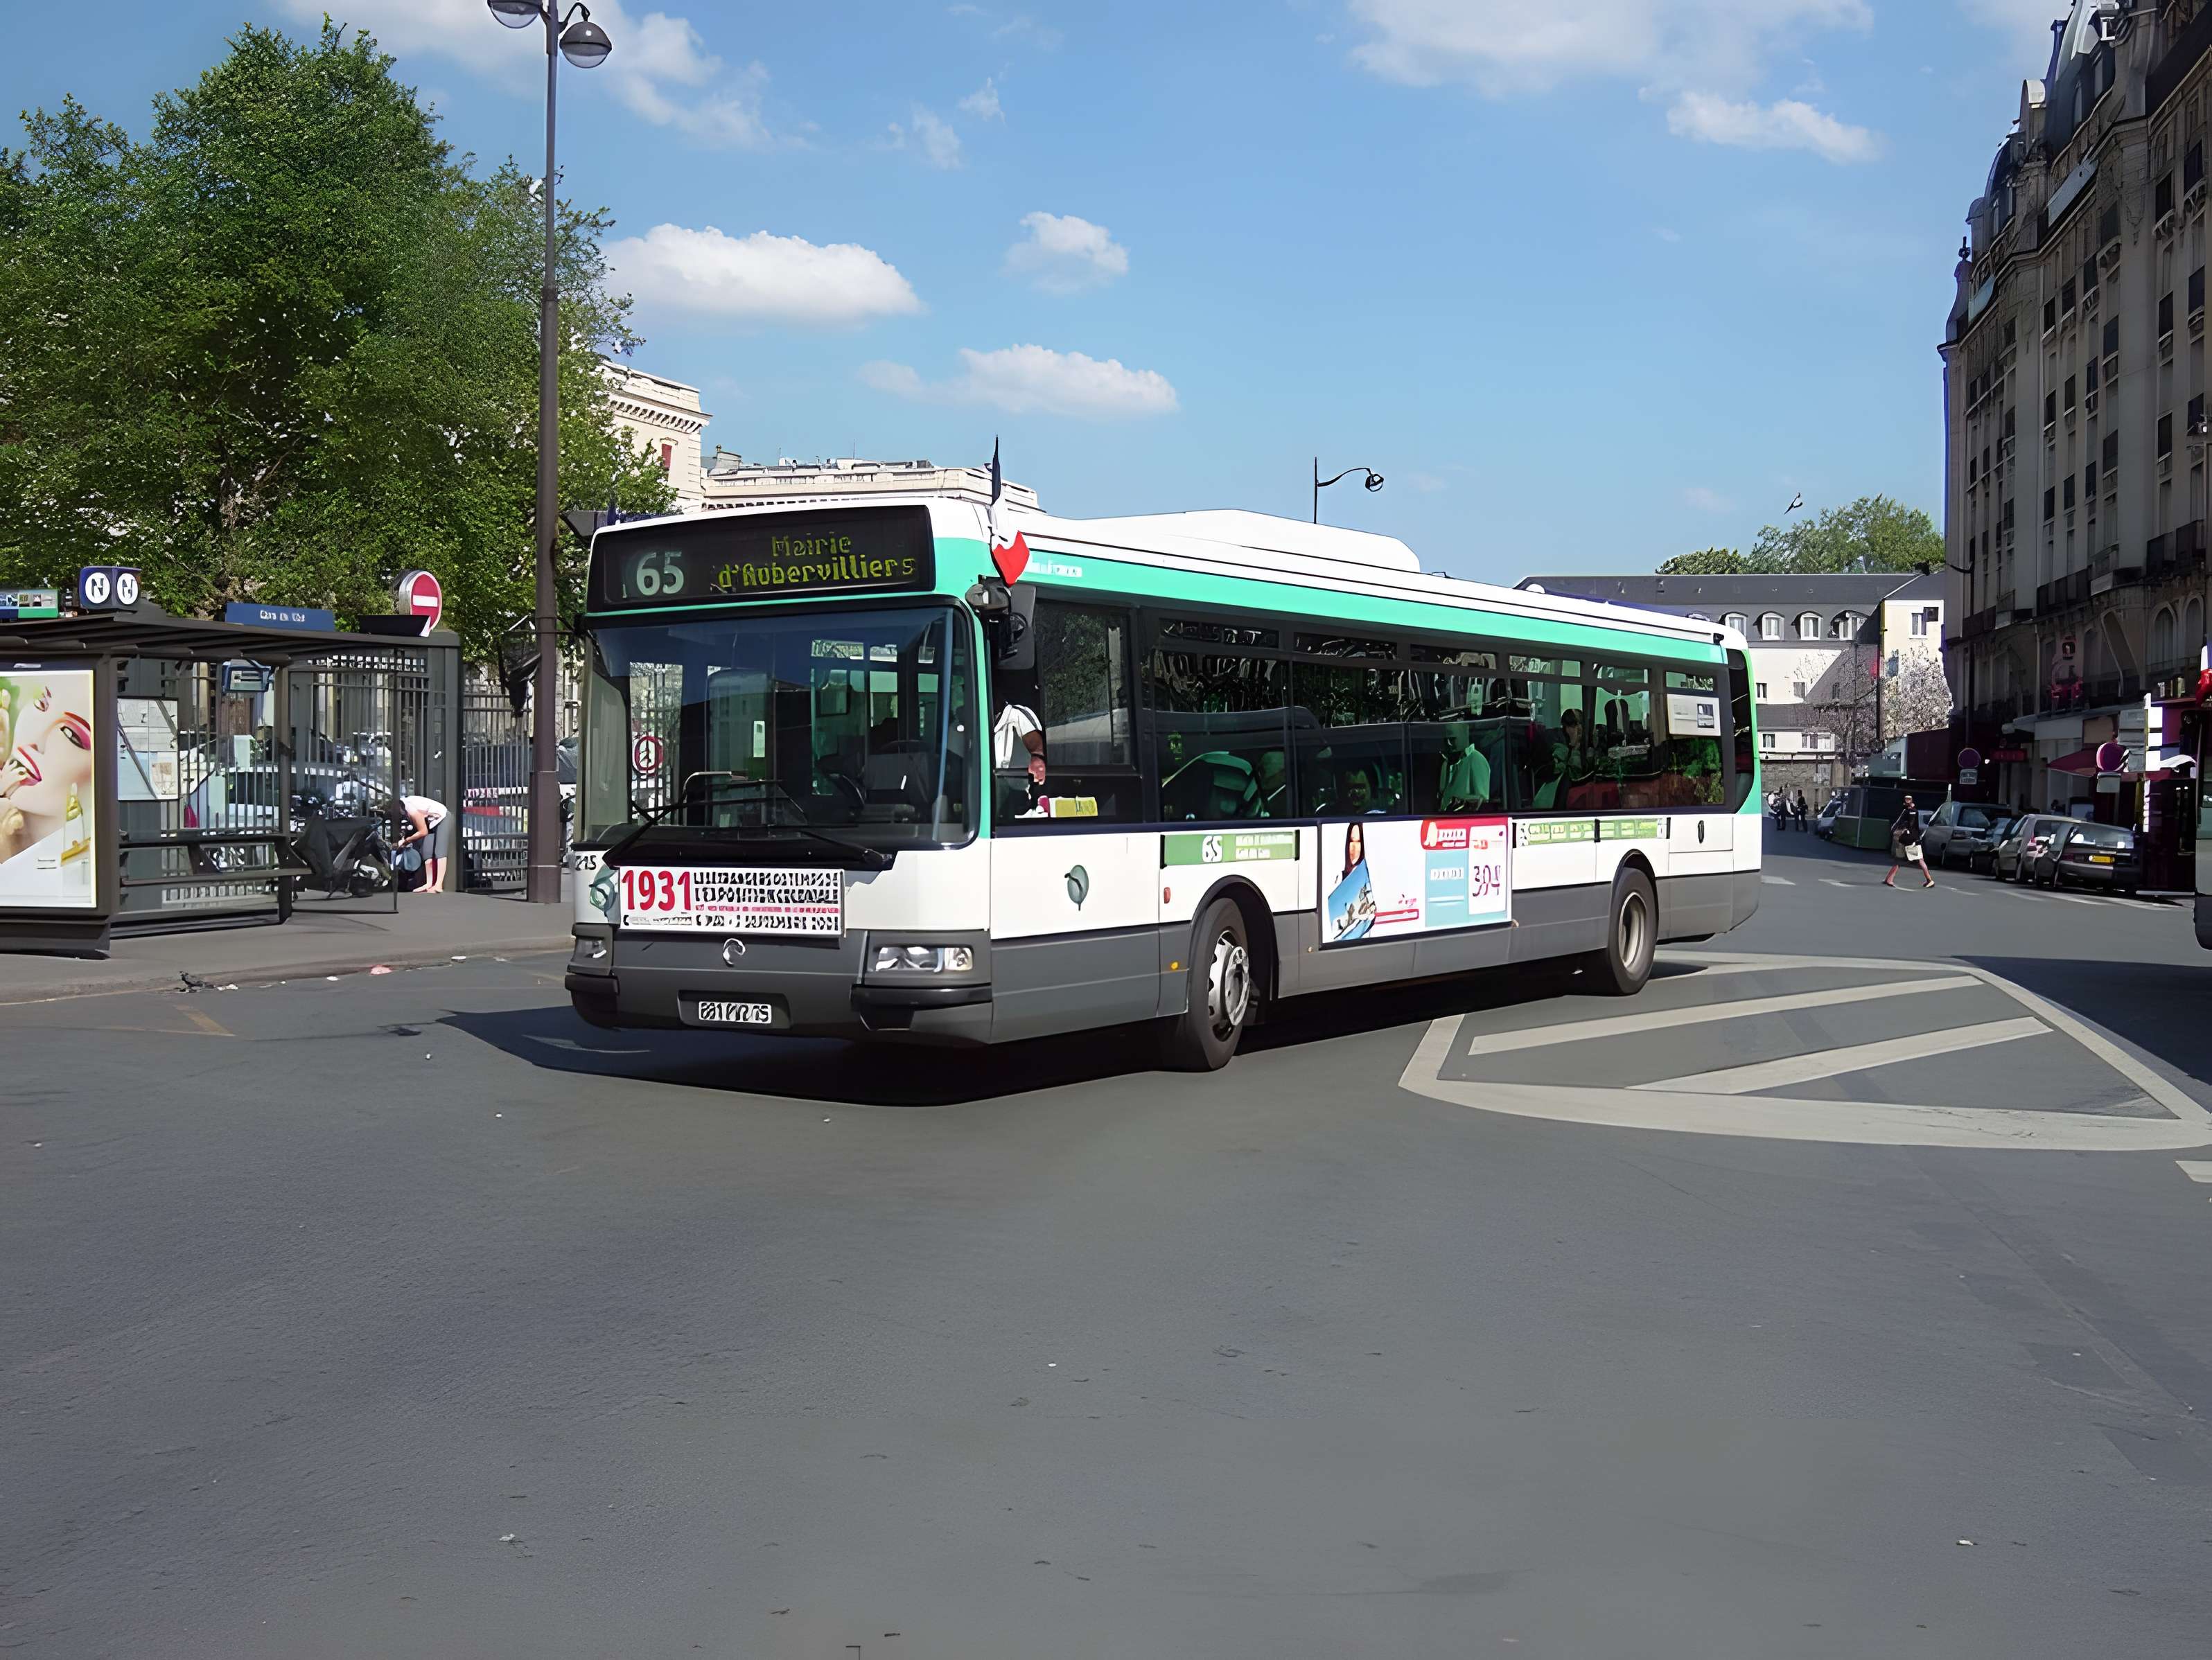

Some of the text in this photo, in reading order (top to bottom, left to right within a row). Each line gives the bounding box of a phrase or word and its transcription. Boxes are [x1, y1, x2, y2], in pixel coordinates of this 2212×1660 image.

[771, 532, 852, 557] Mairie
[635, 551, 685, 596] 65
[717, 554, 915, 588] d'Aubervilliers
[622, 869, 692, 912] 1931
